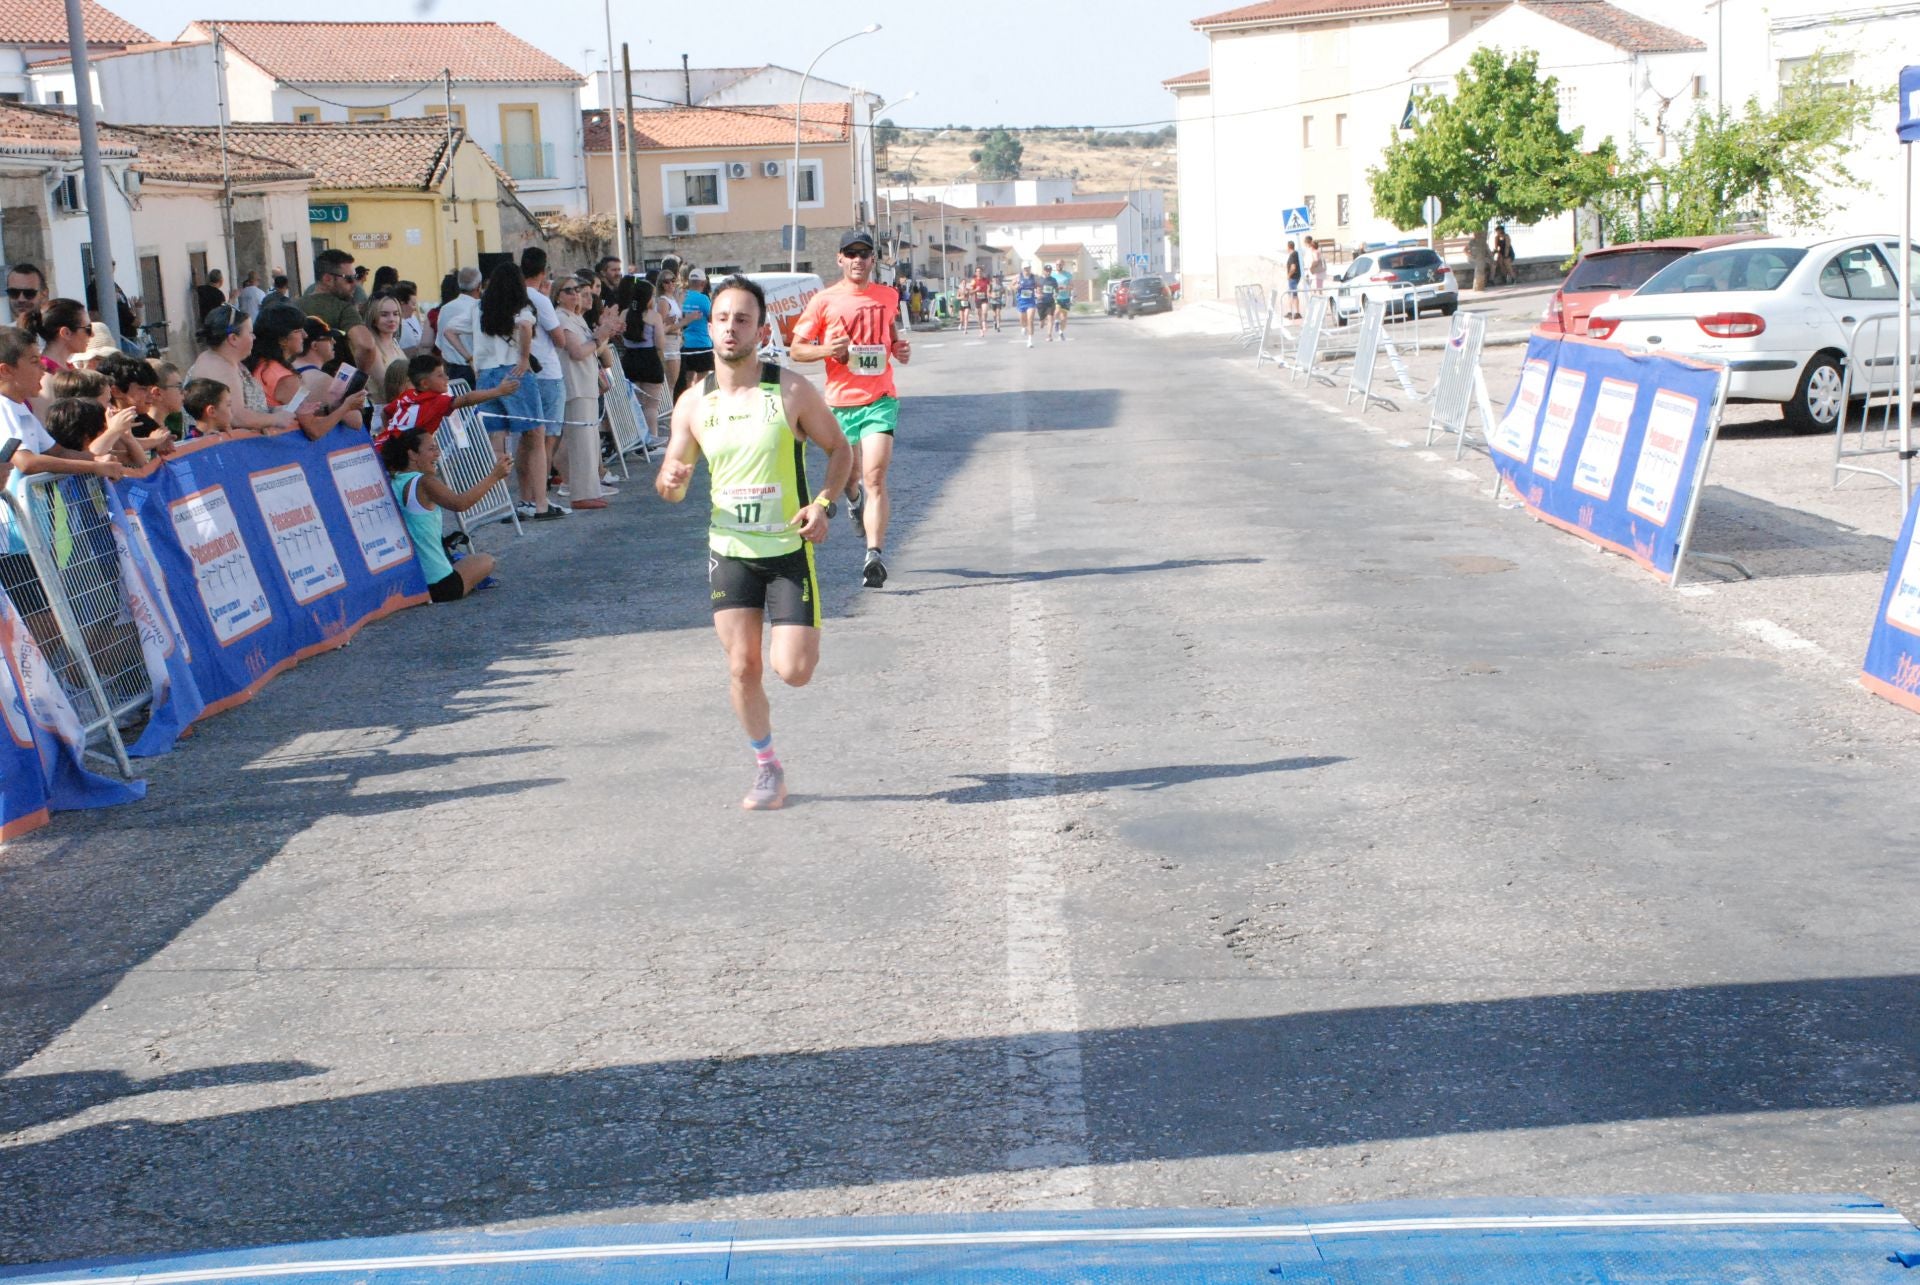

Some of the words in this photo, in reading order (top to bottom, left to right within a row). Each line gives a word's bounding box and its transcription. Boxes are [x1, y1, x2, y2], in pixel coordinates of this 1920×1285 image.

[859, 356, 878, 369] 144
[748, 486, 776, 495] POPULAR
[734, 503, 761, 523] 177
